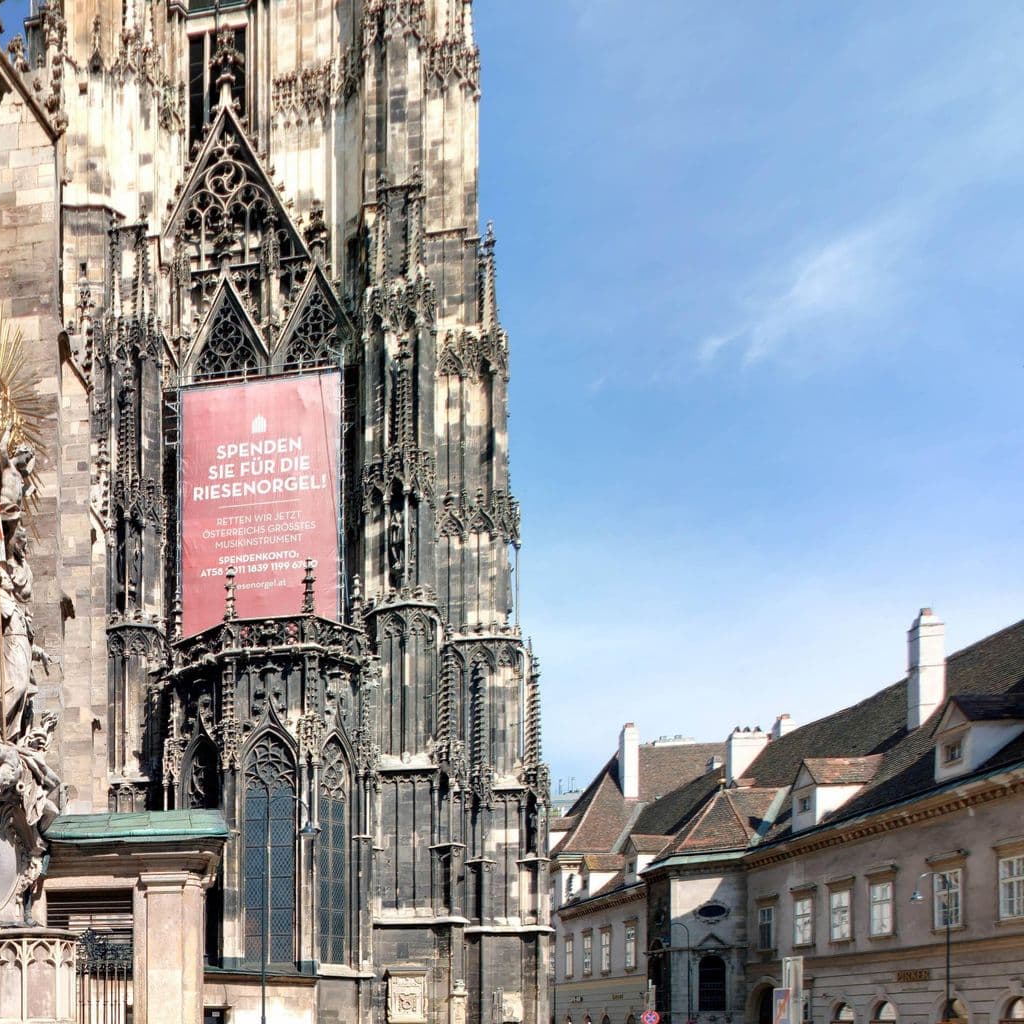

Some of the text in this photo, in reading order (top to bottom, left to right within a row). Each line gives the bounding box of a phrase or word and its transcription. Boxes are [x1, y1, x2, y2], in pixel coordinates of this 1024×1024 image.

[216, 437, 302, 460] SPENDEN
[208, 456, 310, 480] SIE FÜR DIE
[193, 474, 327, 502] RIESENORGEL!
[216, 511, 302, 526] RETTEN WIR JETZT
[202, 525, 266, 539] ÖSTERREICHS
[215, 533, 303, 549] MUSIKINSTRUMENT
